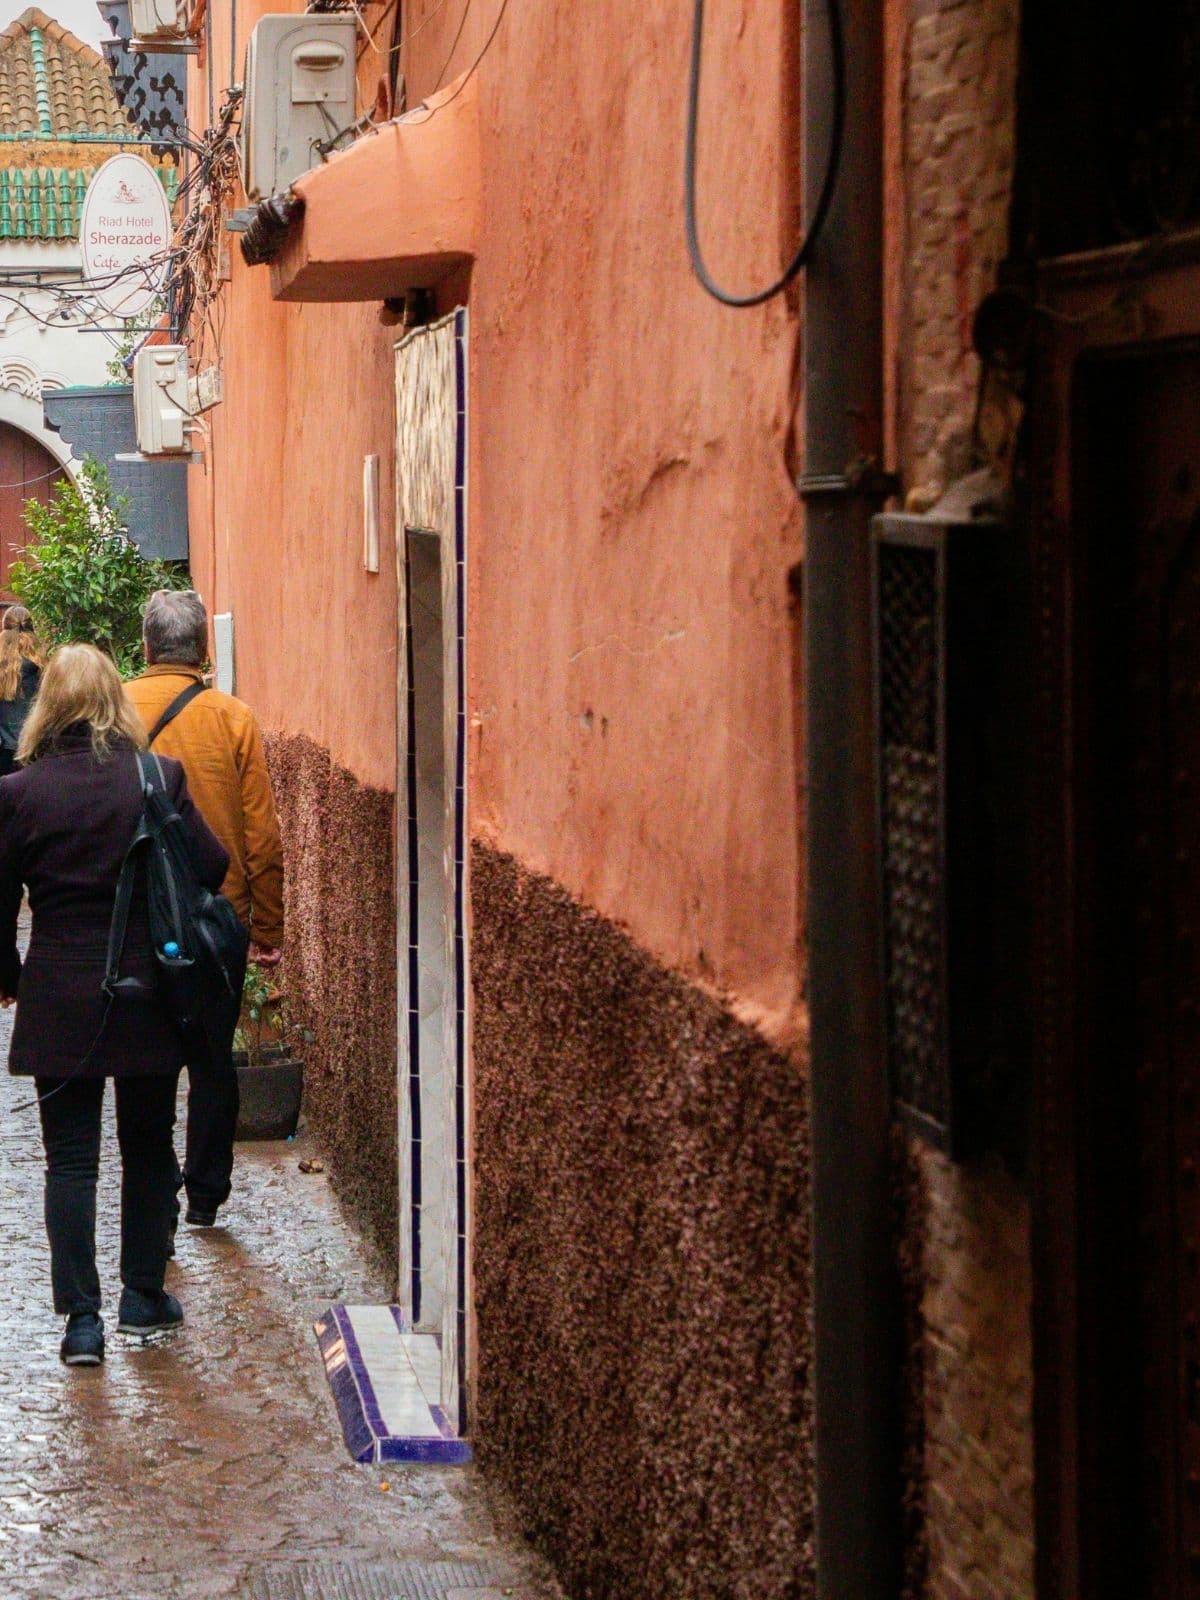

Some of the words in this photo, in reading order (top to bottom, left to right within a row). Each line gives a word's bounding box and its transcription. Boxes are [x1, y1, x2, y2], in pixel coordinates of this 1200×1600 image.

[98, 216, 122, 227] Riad
[126, 216, 154, 227] Hotel
[90, 231, 162, 245] Sherazade
